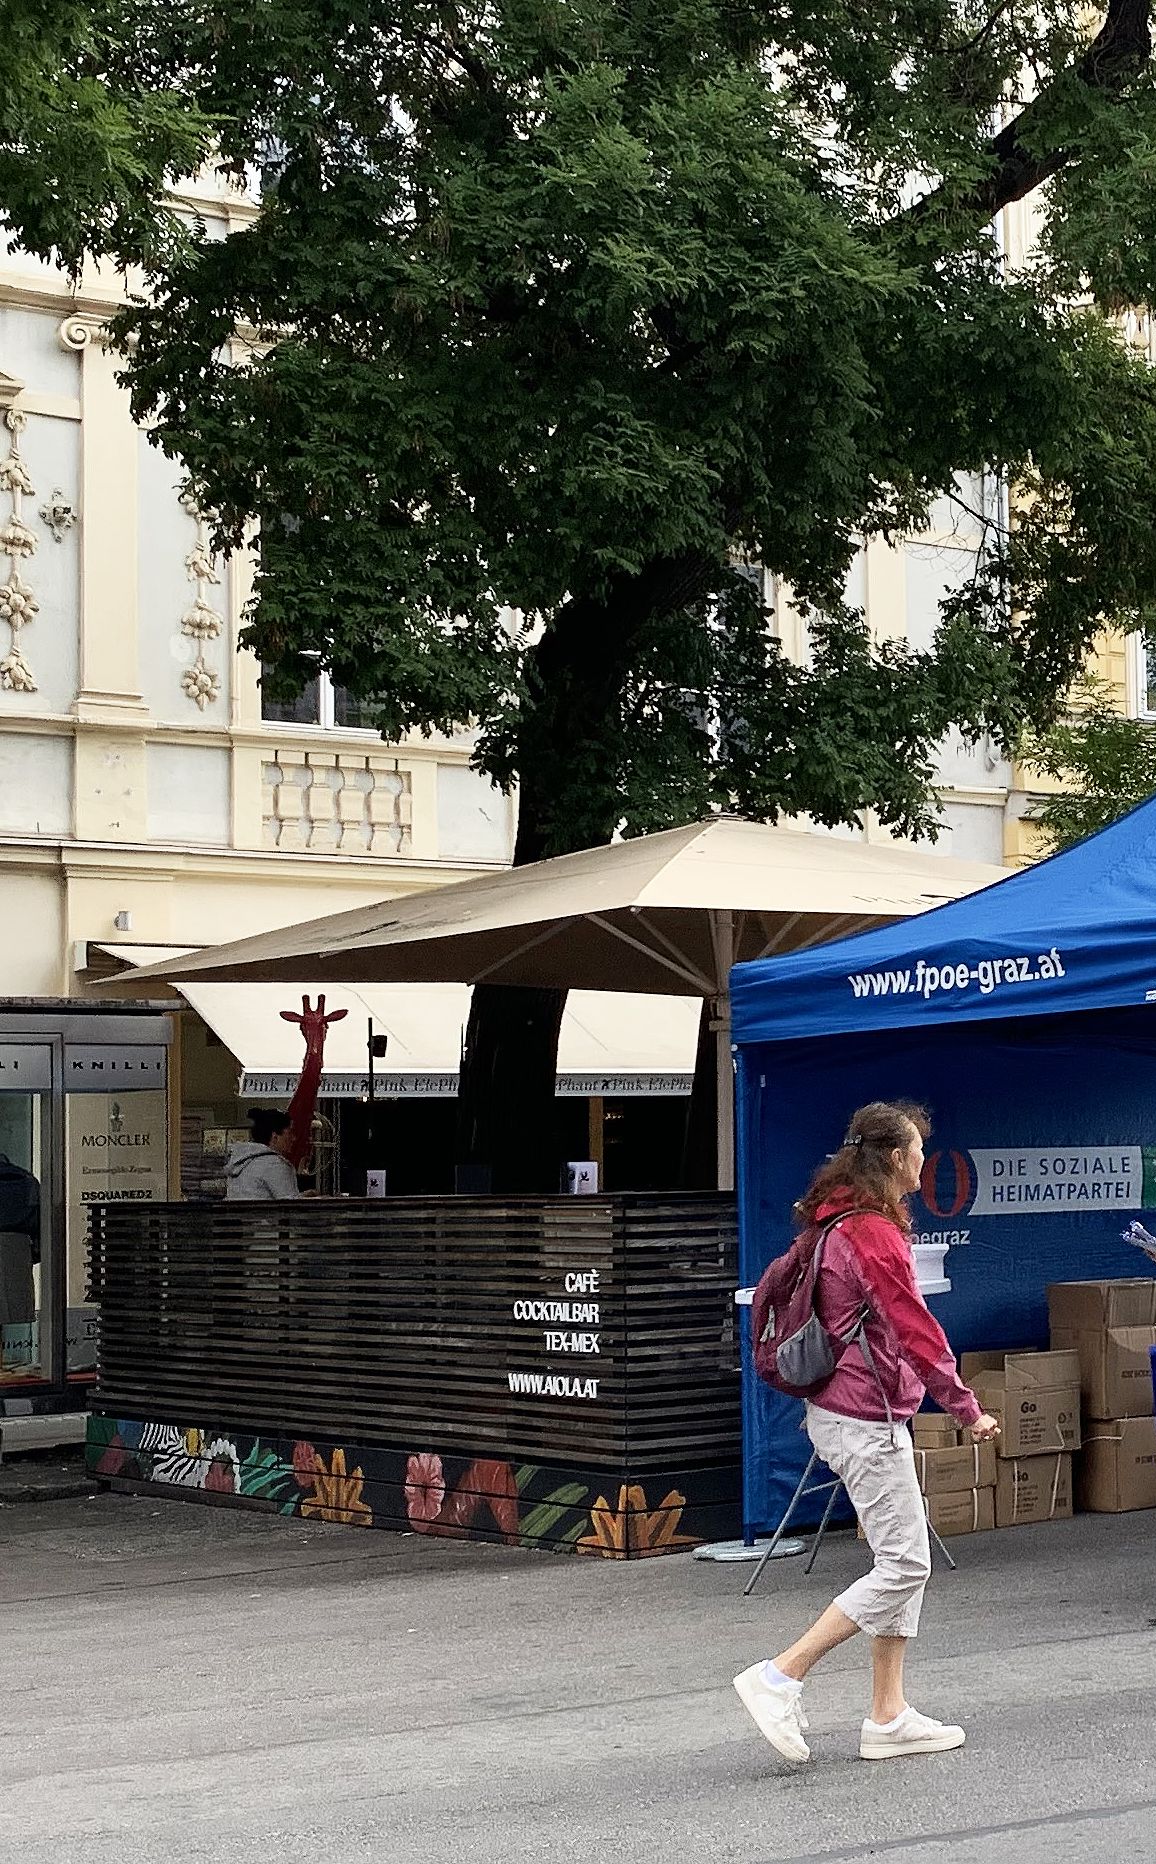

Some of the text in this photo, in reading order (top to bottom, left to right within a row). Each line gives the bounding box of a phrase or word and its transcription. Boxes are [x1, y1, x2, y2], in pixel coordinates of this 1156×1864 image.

[848, 947, 1065, 998] www.fpoe-graz.at
[72, 1061, 161, 1070] KNILLI
[242, 1077, 279, 1093] Pink
[374, 1077, 407, 1093] Pink
[612, 1077, 644, 1092] Pink
[81, 1133, 151, 1147] MONCLER
[992, 1156, 1132, 1178] DIE SOZIALE
[81, 1189, 153, 1201] DSQUARED2
[992, 1180, 1131, 1203] HEIMATPARTEI
[513, 1300, 600, 1324] COCKTAILBAR
[543, 1331, 600, 1354] TEX-MEX
[508, 1372, 600, 1399] WWW.AIOLA.AT
[1020, 1401, 1037, 1414] Go
